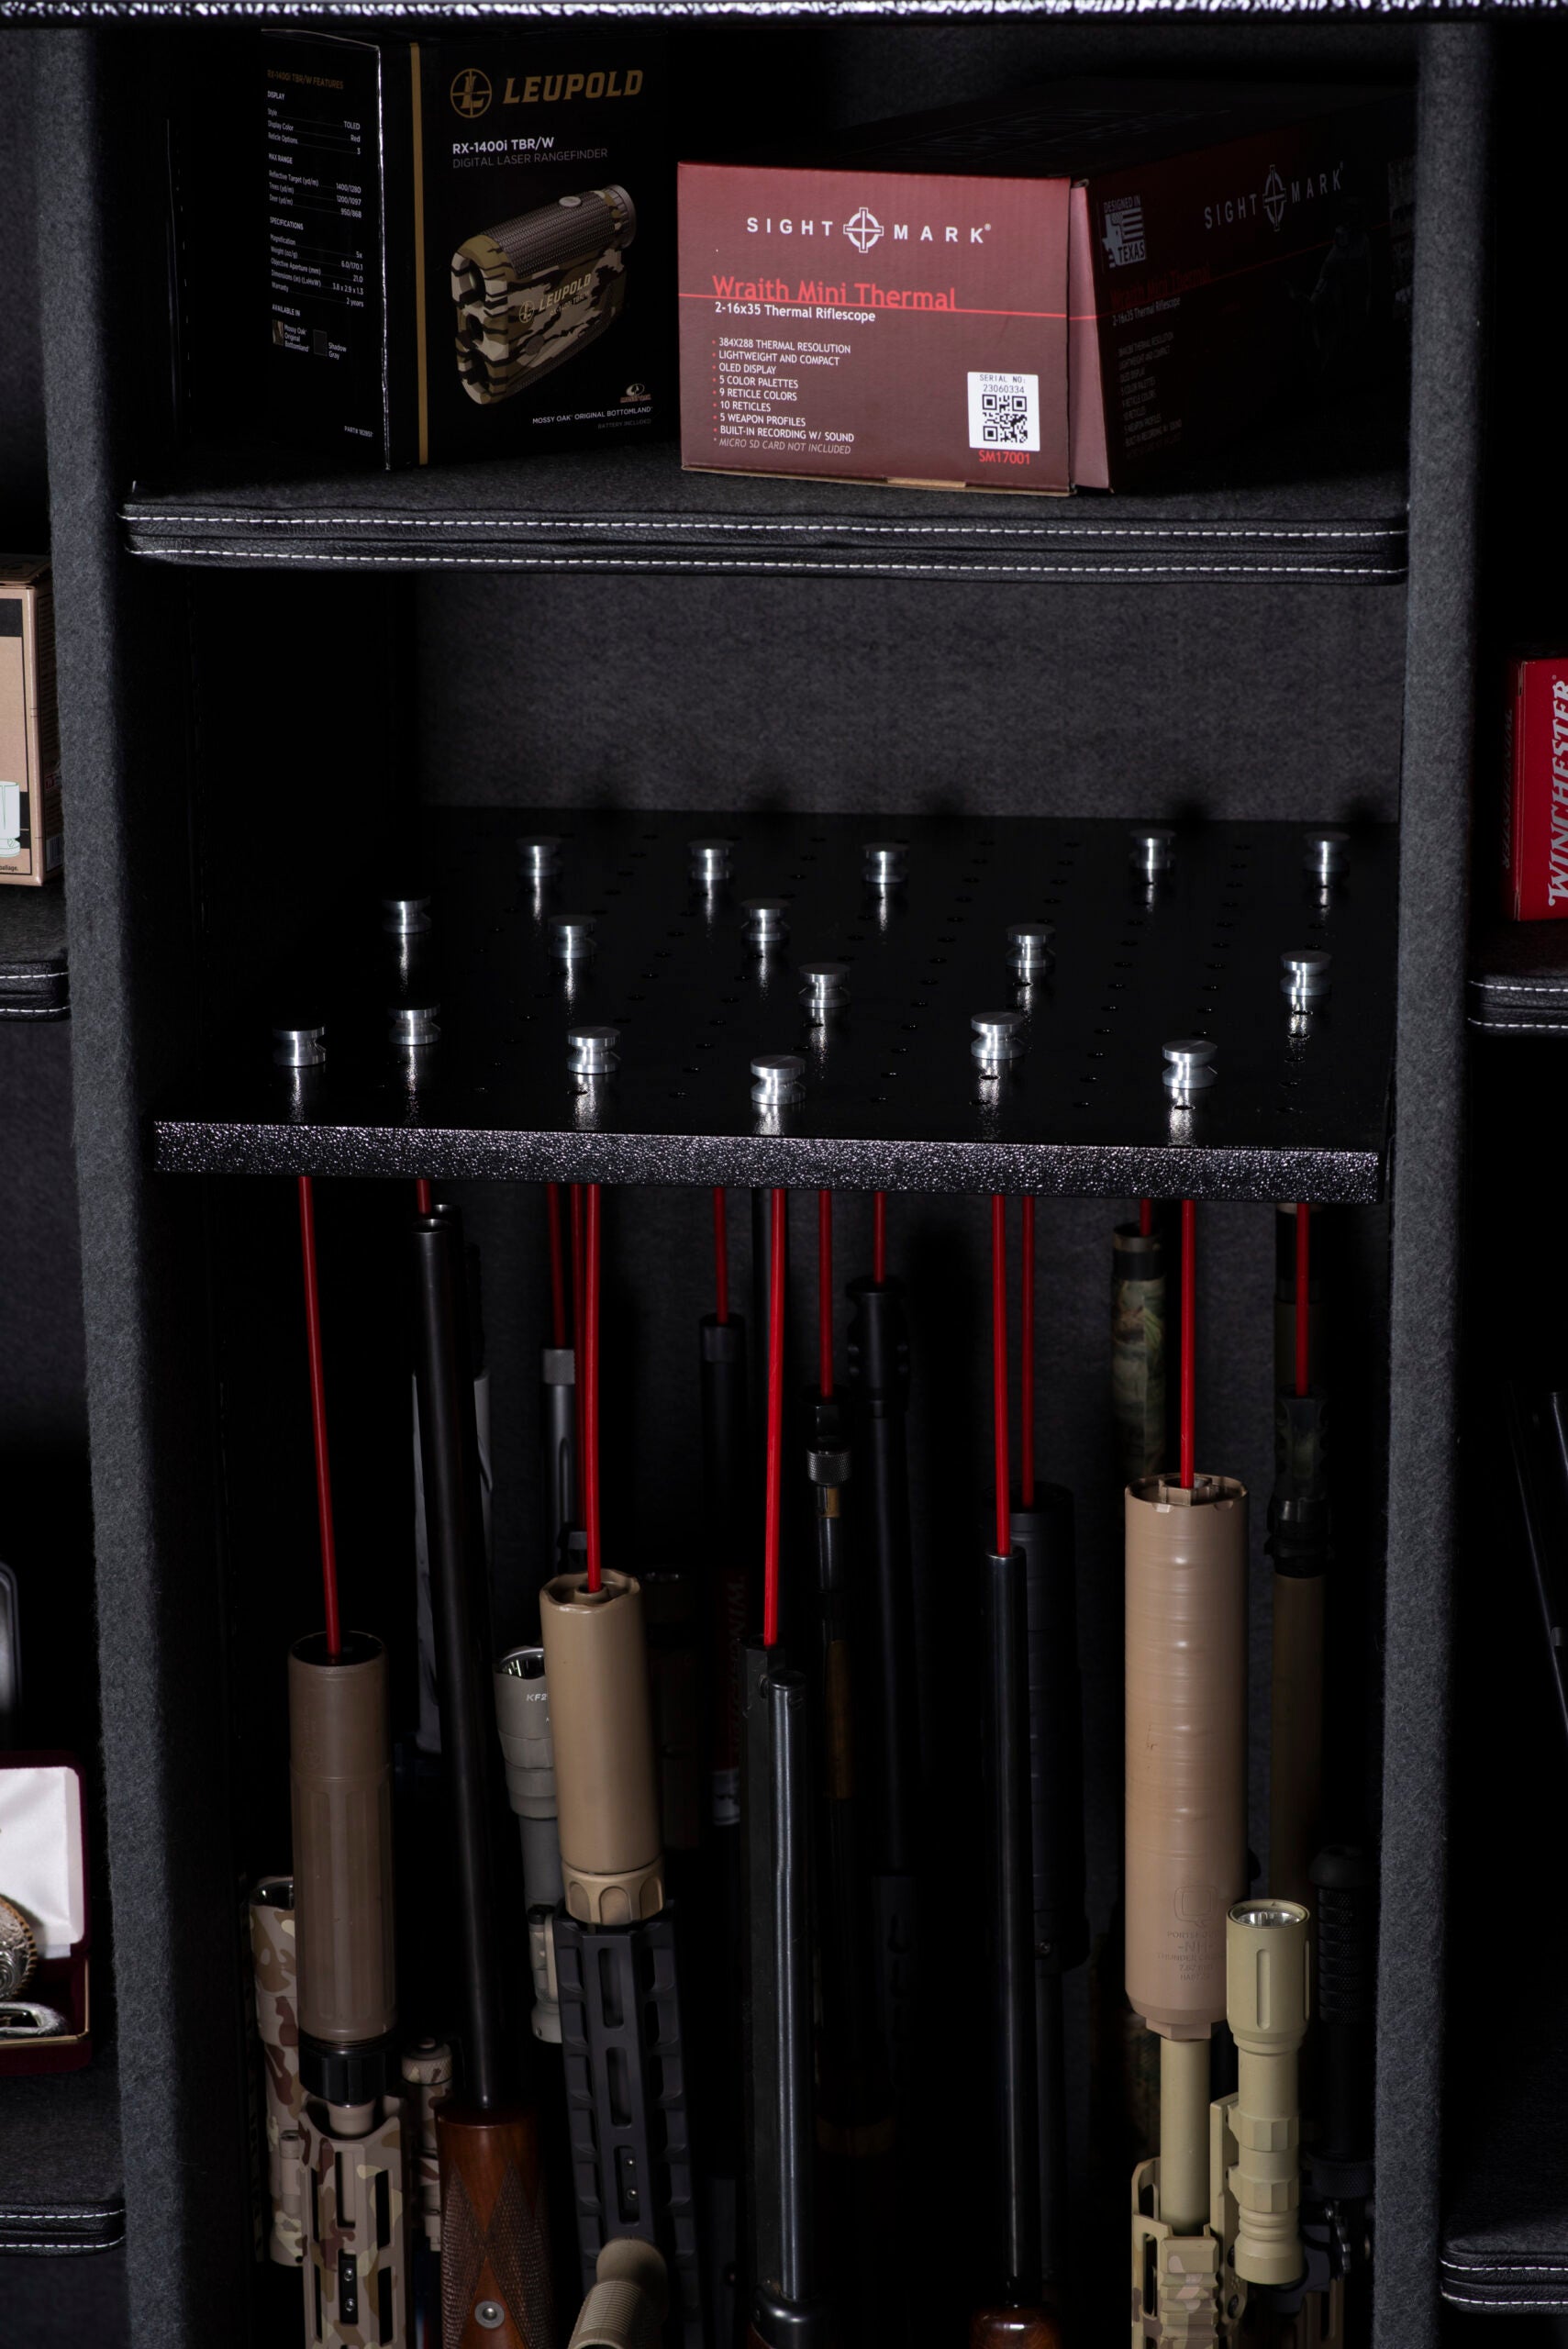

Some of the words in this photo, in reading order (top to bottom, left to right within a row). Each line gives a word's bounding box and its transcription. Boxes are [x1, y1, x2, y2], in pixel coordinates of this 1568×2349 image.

[313, 76, 344, 89] FEATURES
[502, 69, 645, 105] LEUPOLD
[267, 90, 285, 100] DISPLAY
[344, 120, 361, 130] TOLED
[282, 135, 298, 145] Options
[283, 123, 294, 131] Color
[350, 134, 361, 143] Red
[452, 140, 507, 155] RX-1400i
[511, 137, 555, 151] TBR/W
[268, 153, 277, 162] MAX
[278, 154, 294, 164] RANGE
[452, 157, 494, 169] DIGITAL
[497, 153, 531, 166] LASER
[534, 148, 609, 162] RANGEFINDER
[288, 173, 303, 184] Target
[336, 183, 361, 195] 1400/1280
[1103, 196, 1133, 214] DESIGNED
[1133, 195, 1140, 206] IN
[1204, 193, 1258, 230] SIGHT
[747, 217, 833, 236] SIGHT
[1118, 241, 1145, 263] TEXAS
[539, 273, 592, 311] LEUPOLD
[712, 275, 789, 302] Wraith
[797, 280, 847, 305] Mini
[854, 283, 956, 309] Thermal
[350, 299, 364, 308] years
[1134, 303, 1154, 319] Thermal
[295, 309, 301, 317] IN
[715, 302, 762, 316] 2-16x35
[764, 304, 812, 318] Thermal
[816, 306, 876, 324] Riflescope
[328, 341, 347, 352] Shadow
[718, 338, 754, 348] 384X288
[756, 340, 795, 351] THERMAL
[797, 342, 851, 354] RESOLUTION
[328, 351, 340, 361] Gray
[718, 350, 778, 362] LIGHTWEIGHT
[779, 354, 797, 363] AND
[799, 354, 840, 366] COMPACT
[718, 362, 741, 373] OLED
[743, 364, 777, 374] DISPLAY
[719, 375, 725, 384] 5
[727, 375, 756, 385] COLOR
[758, 377, 799, 388] PALETTES
[980, 374, 1006, 383] SERIAL
[1013, 375, 1026, 384] NO:
[719, 388, 725, 396] 9
[727, 388, 762, 399] RETICLE
[763, 390, 797, 401] COLORS
[983, 384, 1025, 394] 23060334
[720, 401, 730, 409] 10
[732, 401, 772, 412] RETICLES
[532, 416, 555, 425] MOSSY
[574, 411, 606, 420] ORIGINAL
[719, 413, 726, 421] 5
[728, 413, 764, 424] WEAPON
[766, 416, 806, 427] PROFILES
[720, 426, 755, 436] BUILT-IN
[757, 428, 806, 440] RECORDING
[809, 431, 822, 440] W/
[825, 432, 855, 442] SOUND
[718, 439, 747, 448] MICRO
[749, 440, 761, 449] SD
[762, 440, 785, 450] CARD
[787, 442, 806, 451] NOT
[808, 443, 851, 454] INCLUDED
[978, 449, 1030, 464] SM17001
[1548, 679, 1568, 907] WINCHESTER
